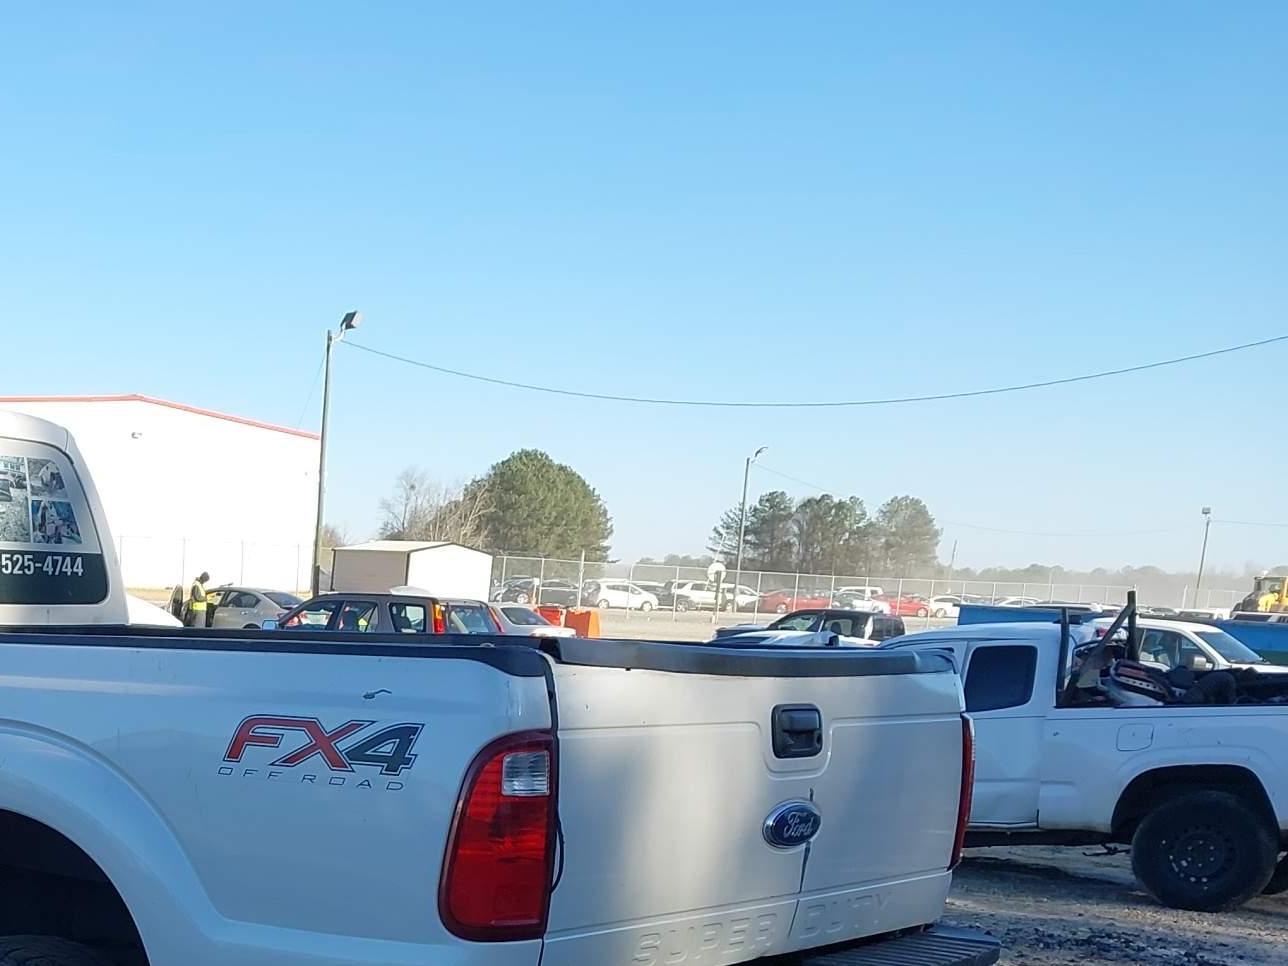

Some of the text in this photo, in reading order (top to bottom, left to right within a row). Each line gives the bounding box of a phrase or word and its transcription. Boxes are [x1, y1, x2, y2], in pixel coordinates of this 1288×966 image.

[223, 714, 425, 776] FX4
[783, 811, 815, 838] Ford
[799, 891, 894, 940] DUTY
